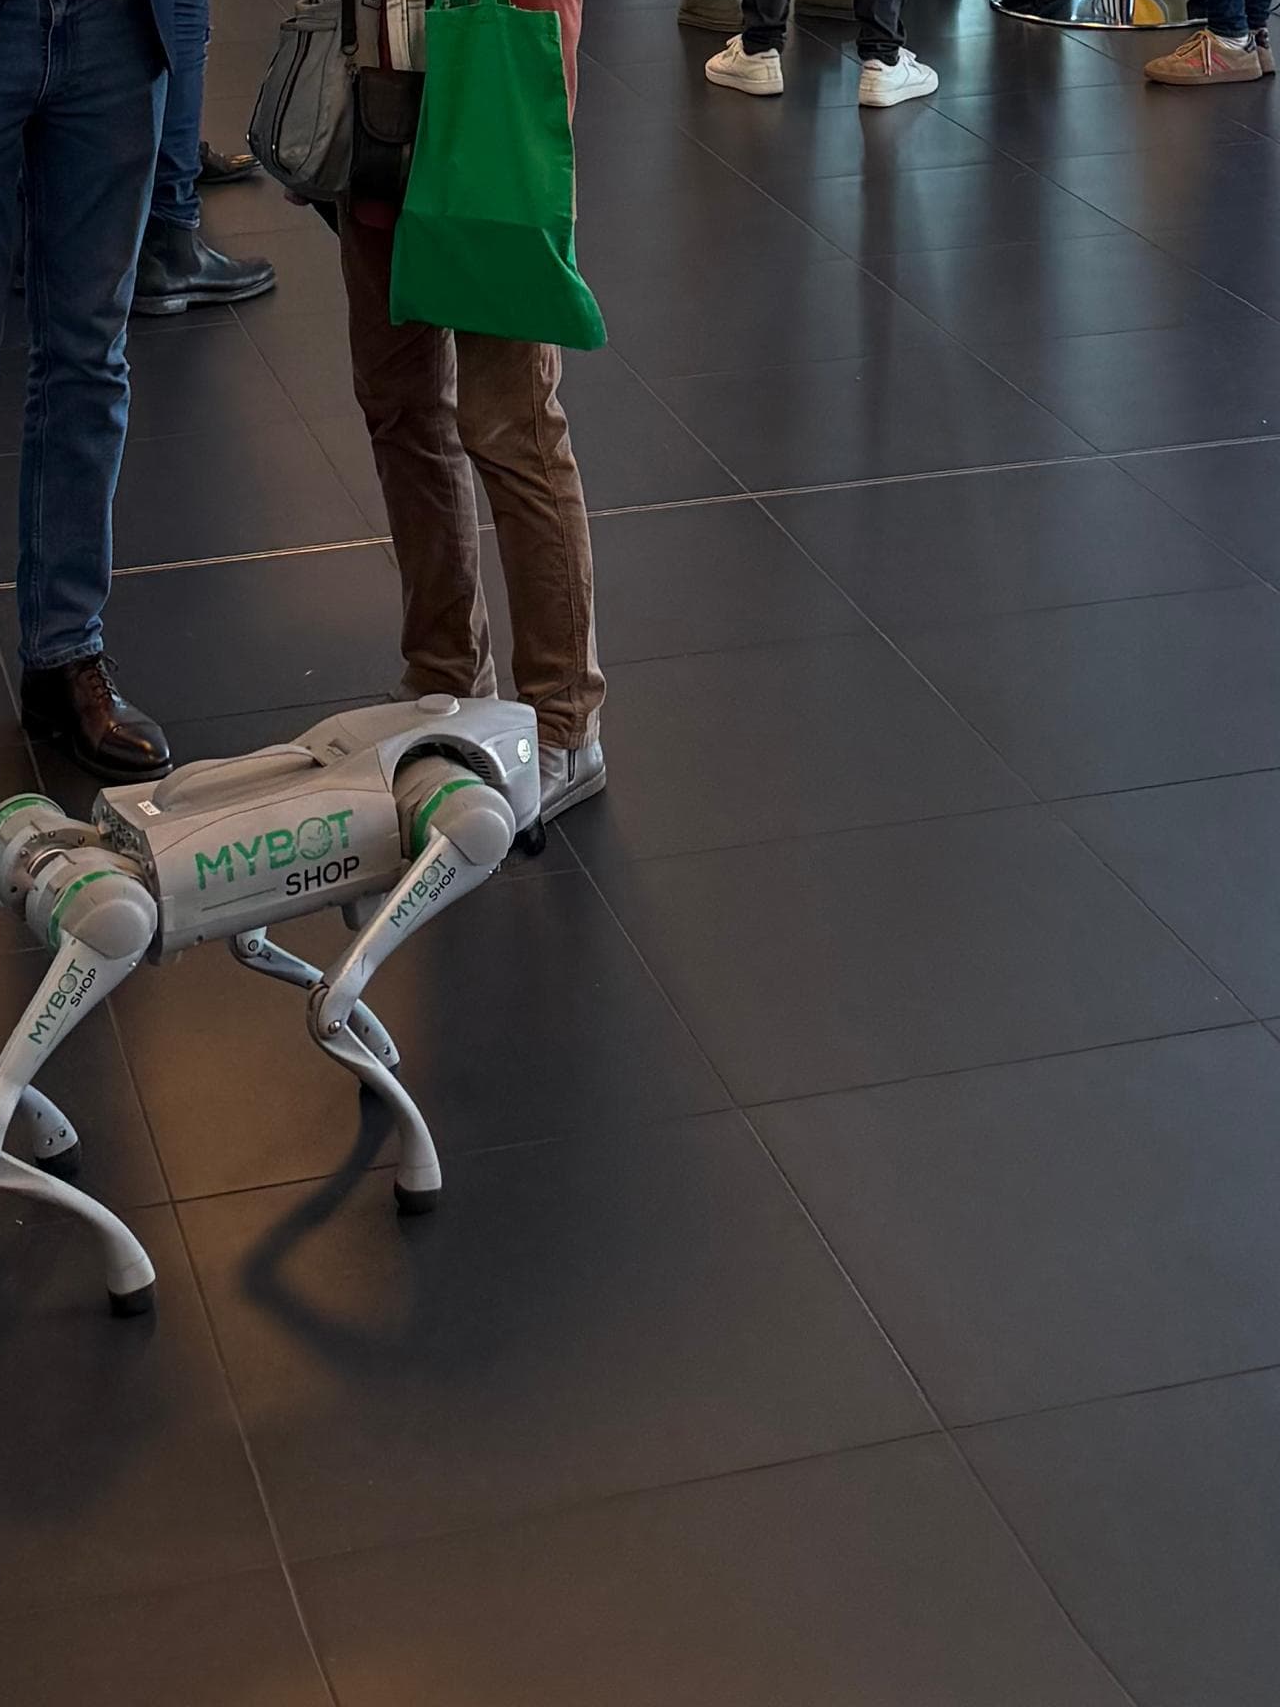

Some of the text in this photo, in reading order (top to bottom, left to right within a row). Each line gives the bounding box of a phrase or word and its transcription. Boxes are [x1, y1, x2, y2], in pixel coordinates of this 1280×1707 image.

[195, 809, 354, 891] MYBOT
[286, 856, 360, 896] SHOP
[389, 853, 447, 928] MYBOT
[428, 867, 456, 902] SHOP
[28, 958, 84, 1045] MYBOT
[70, 968, 97, 1008] SHOP
